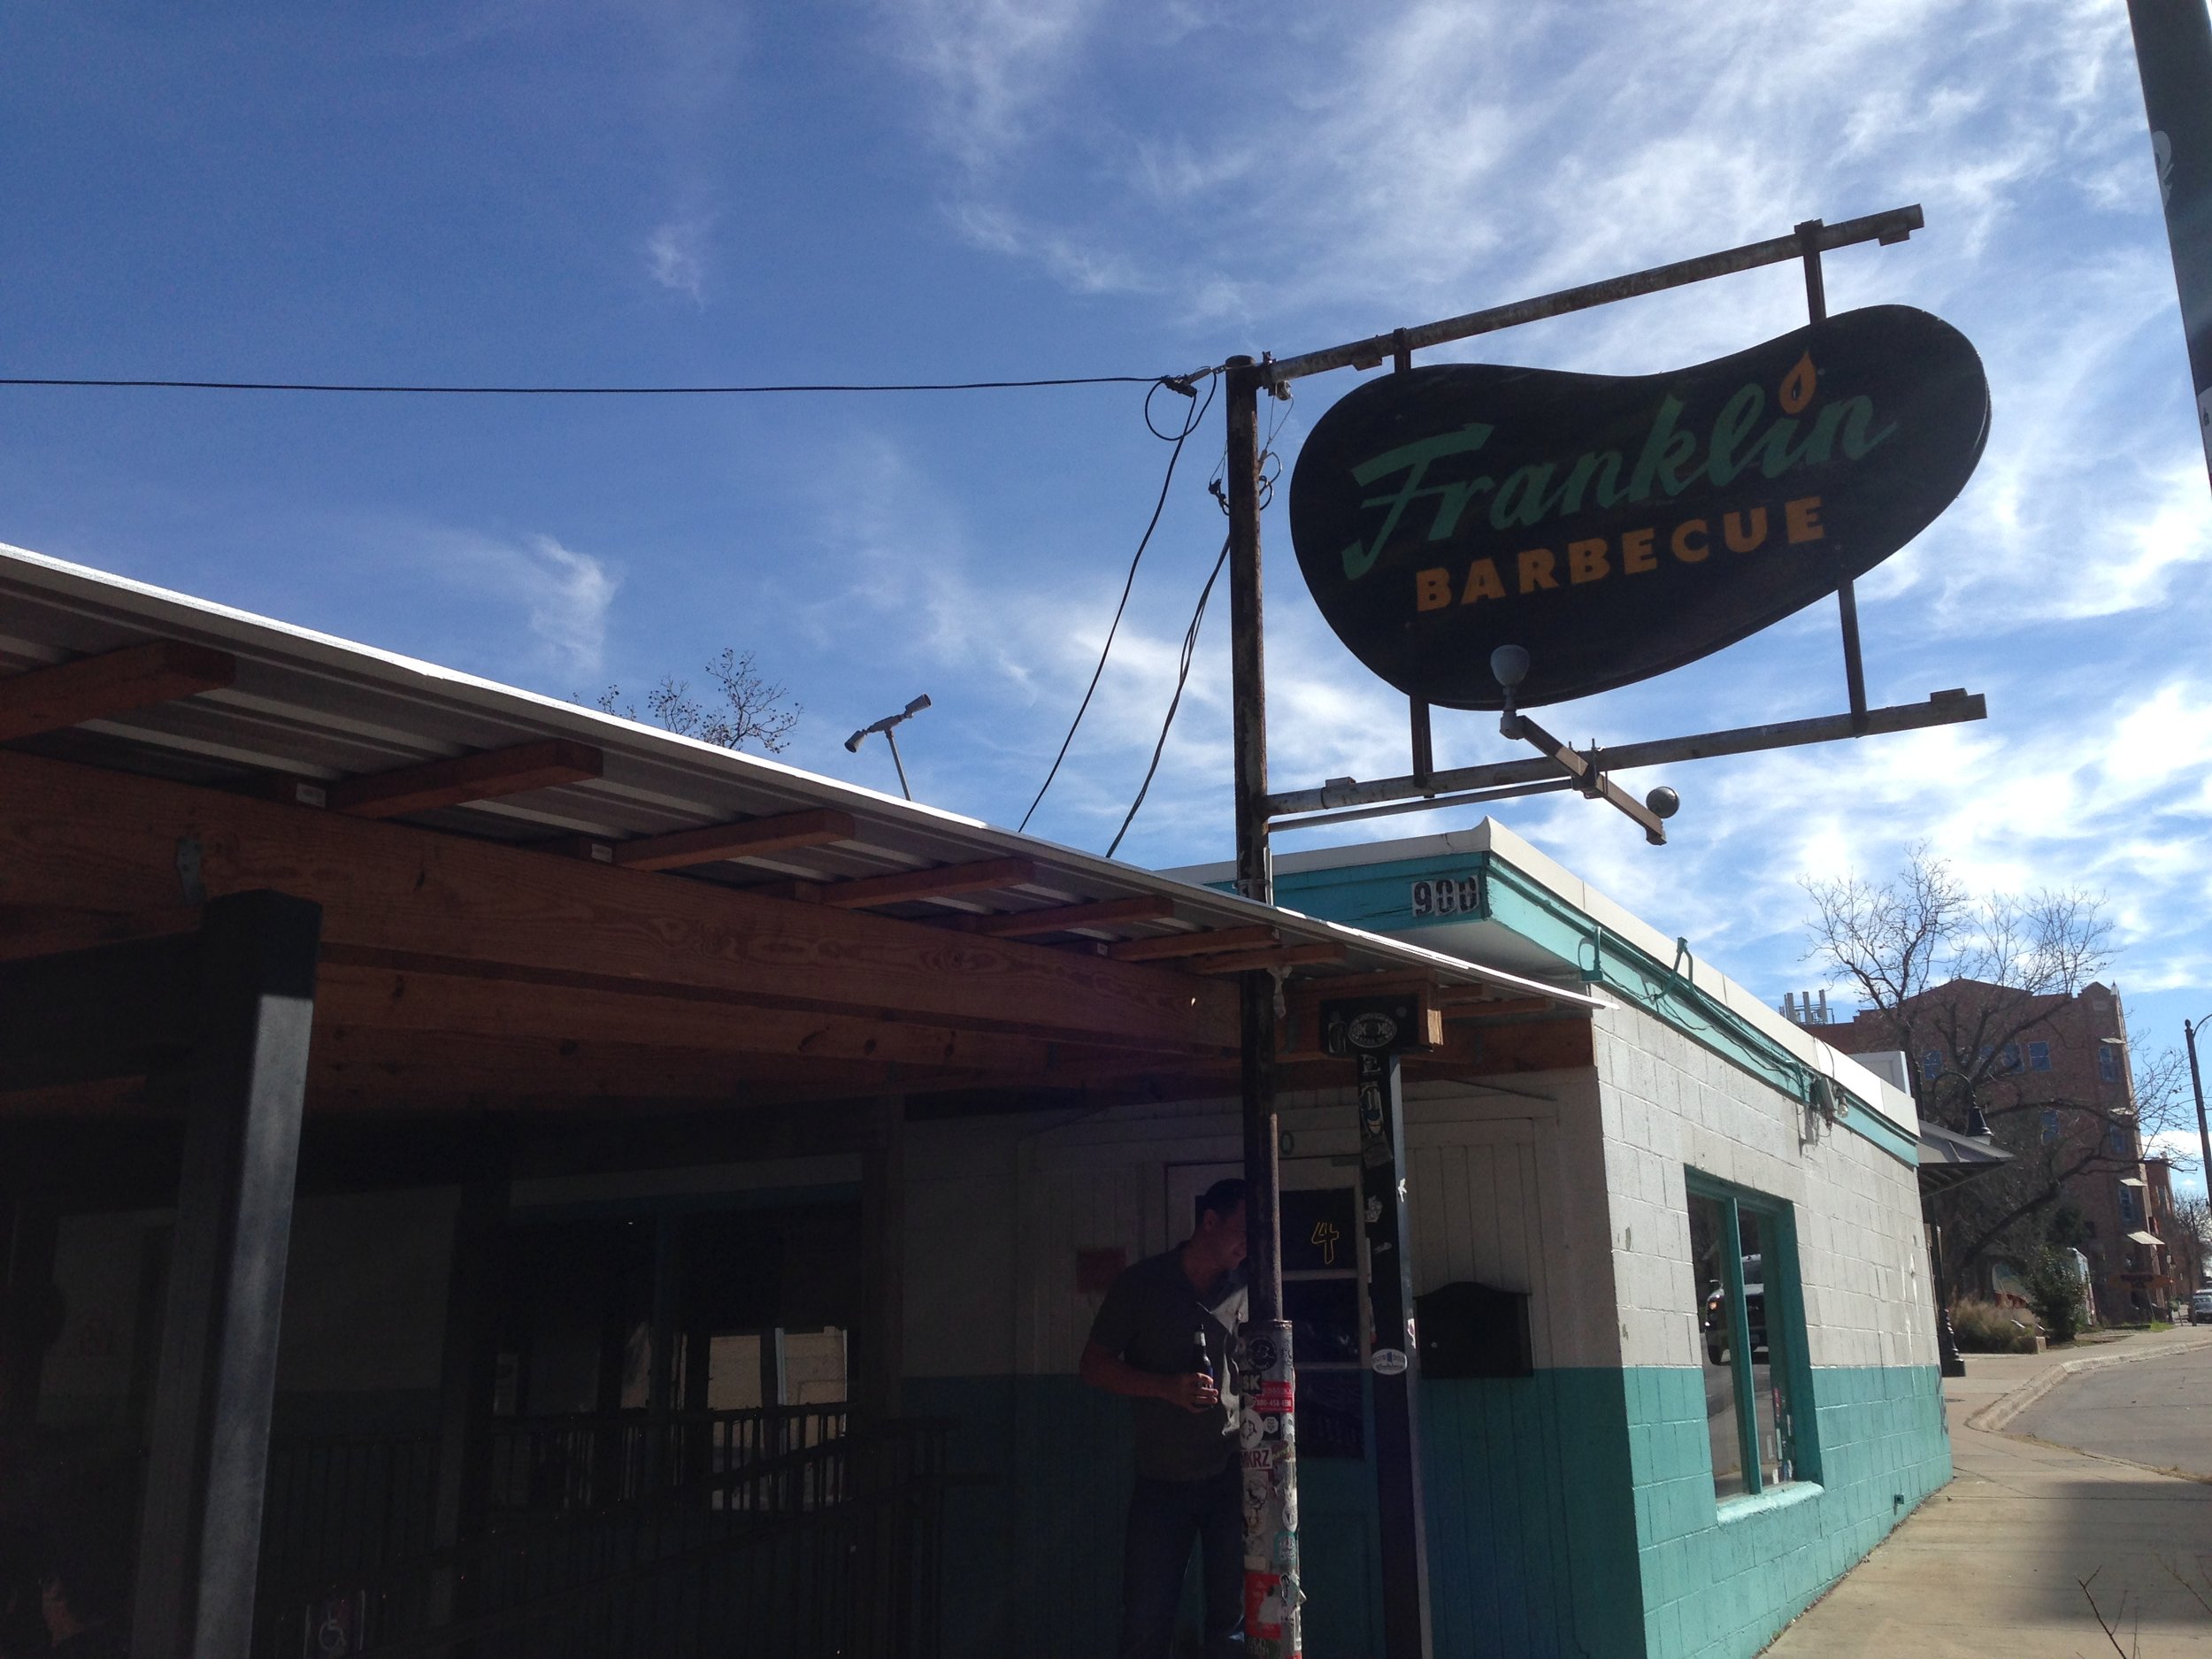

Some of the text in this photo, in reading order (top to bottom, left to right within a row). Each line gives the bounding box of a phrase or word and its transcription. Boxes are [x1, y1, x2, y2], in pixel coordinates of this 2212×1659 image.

[1340, 350, 1898, 580] Franklin
[1416, 496, 1825, 612] BARBECUE
[1414, 876, 1477, 916] 900
